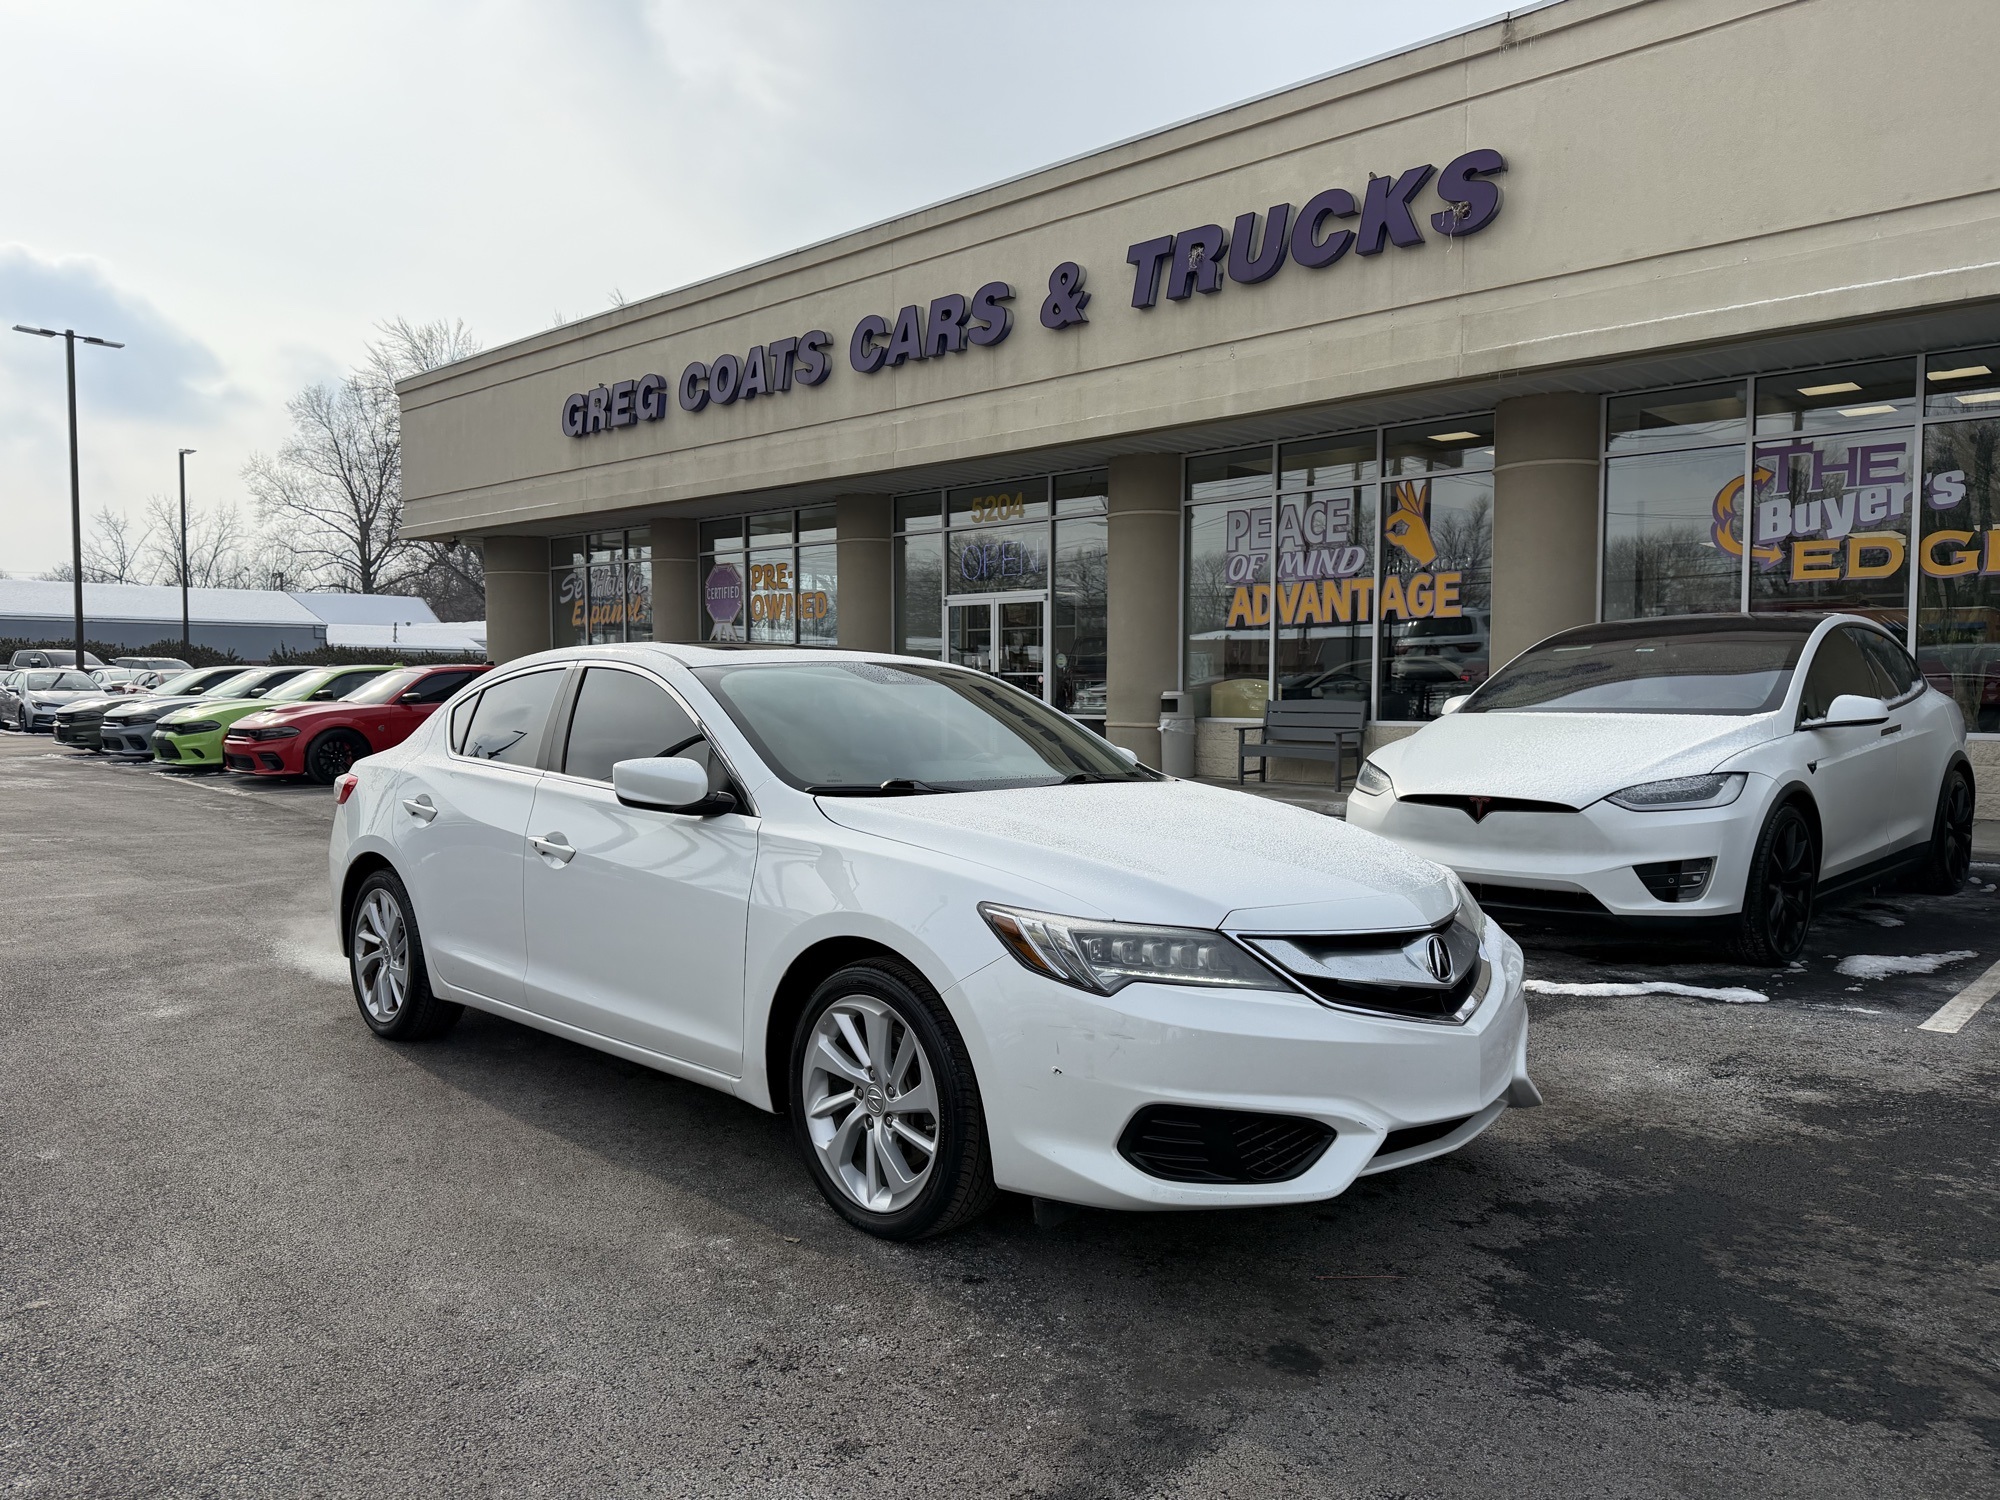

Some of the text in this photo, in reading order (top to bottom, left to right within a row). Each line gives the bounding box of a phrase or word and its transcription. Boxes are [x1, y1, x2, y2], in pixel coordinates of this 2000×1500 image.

[562, 149, 1508, 438] GREG COATS CARS & TRUCKS
[1755, 441, 1906, 496] THE
[971, 491, 1025, 523] 5204
[1226, 498, 1350, 552] PEACE
[1758, 470, 1967, 544] Buyer's
[750, 562, 793, 592] PRE-
[961, 538, 1040, 580] OPEN
[1226, 552, 1268, 584] OF
[1277, 546, 1367, 582] MIND
[560, 573, 583, 604] Se
[706, 585, 740, 600] CERTIFIED
[751, 591, 828, 622] OWNED
[1226, 571, 1463, 628] ADVANTAGE
